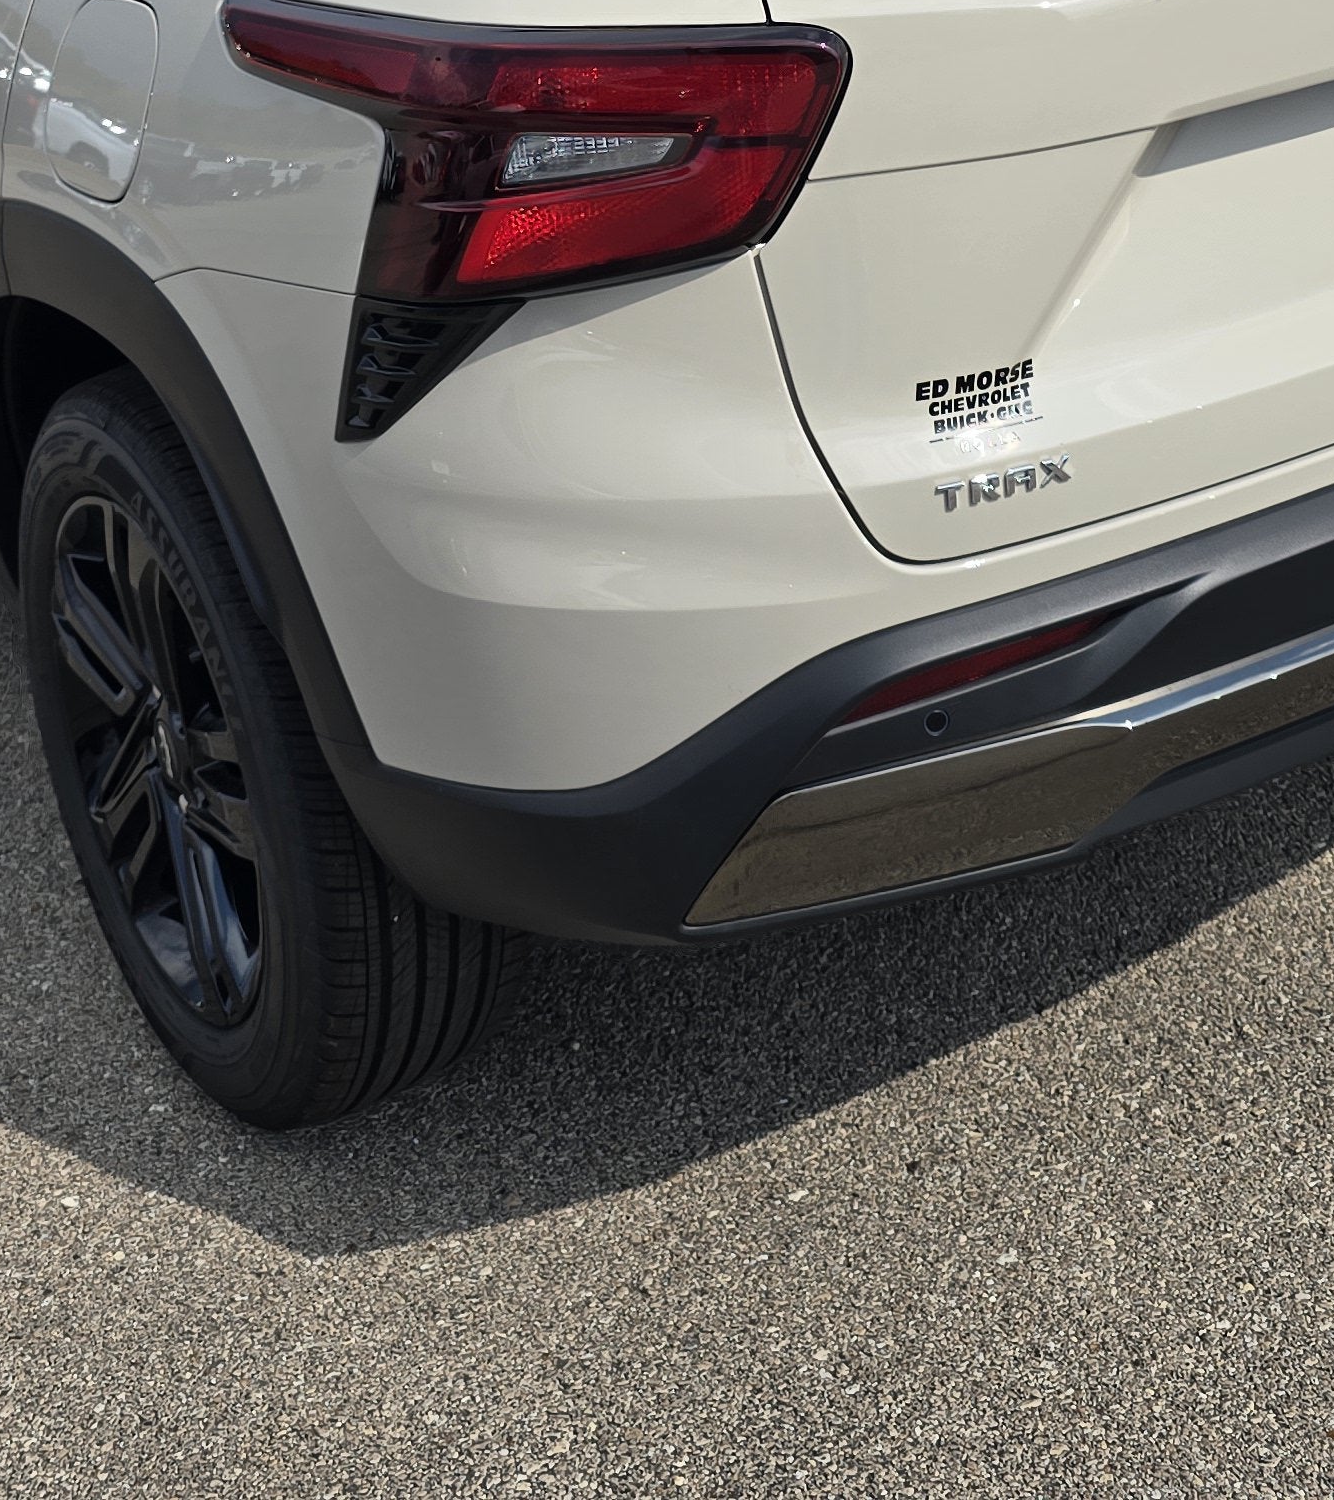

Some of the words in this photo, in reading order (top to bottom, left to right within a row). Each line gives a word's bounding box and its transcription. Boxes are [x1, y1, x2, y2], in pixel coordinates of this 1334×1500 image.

[915, 378, 949, 402] ED
[955, 358, 1034, 395] MORSE
[928, 381, 1030, 417] CHEVROLET
[934, 453, 1072, 513] TRAX
